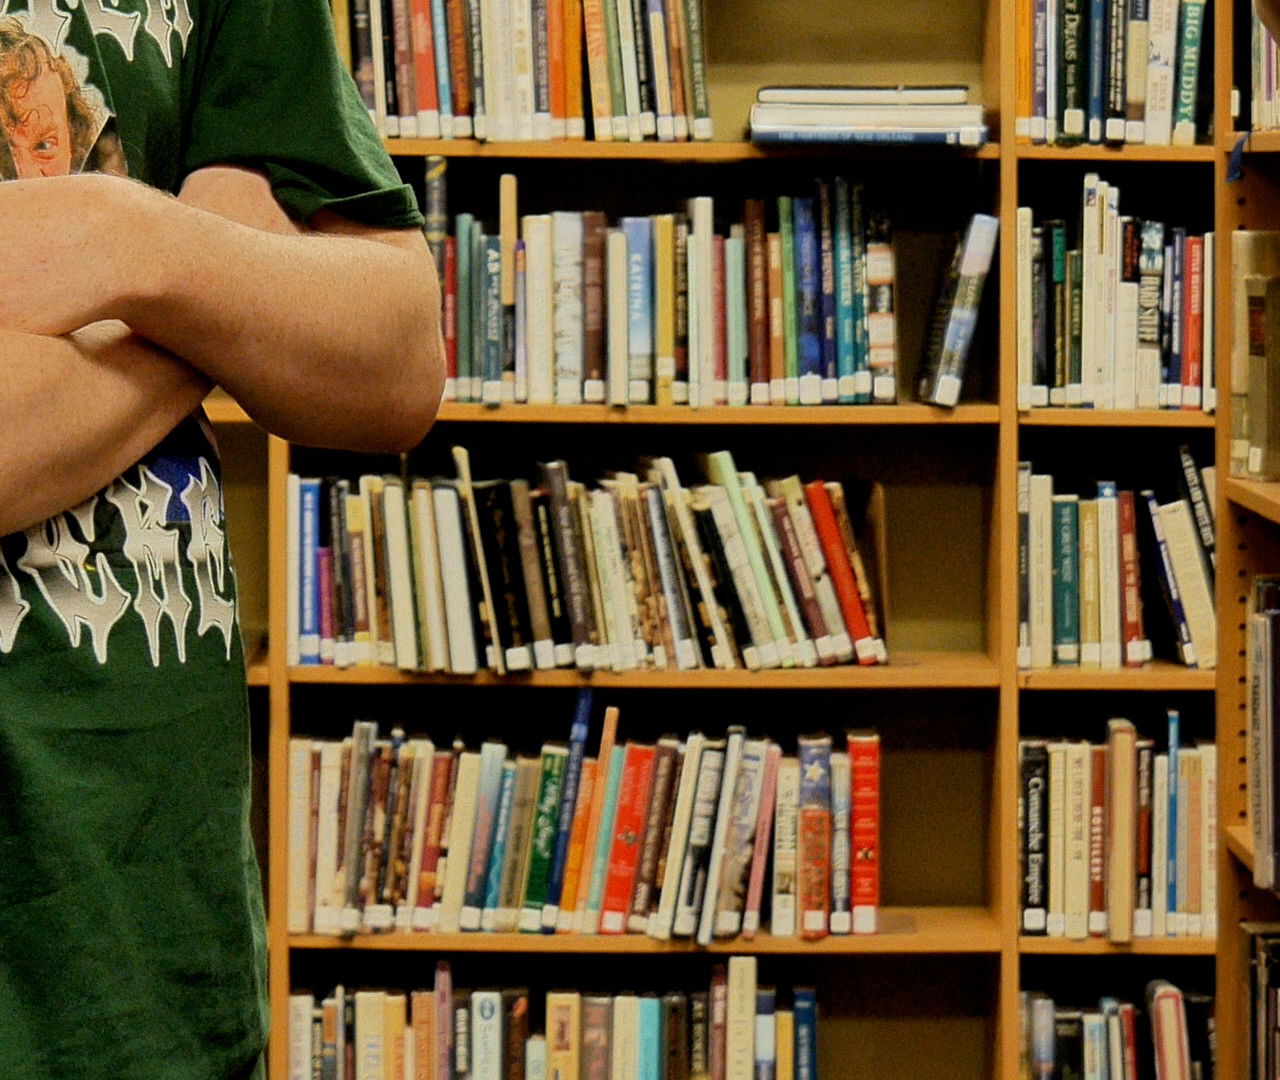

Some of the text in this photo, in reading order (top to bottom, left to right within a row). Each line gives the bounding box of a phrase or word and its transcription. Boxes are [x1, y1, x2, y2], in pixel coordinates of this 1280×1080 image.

[1064, 14, 1080, 61] DREAMS
[1180, 5, 1200, 116] BIG MUDDY
[1024, 854, 1044, 905] Empire
